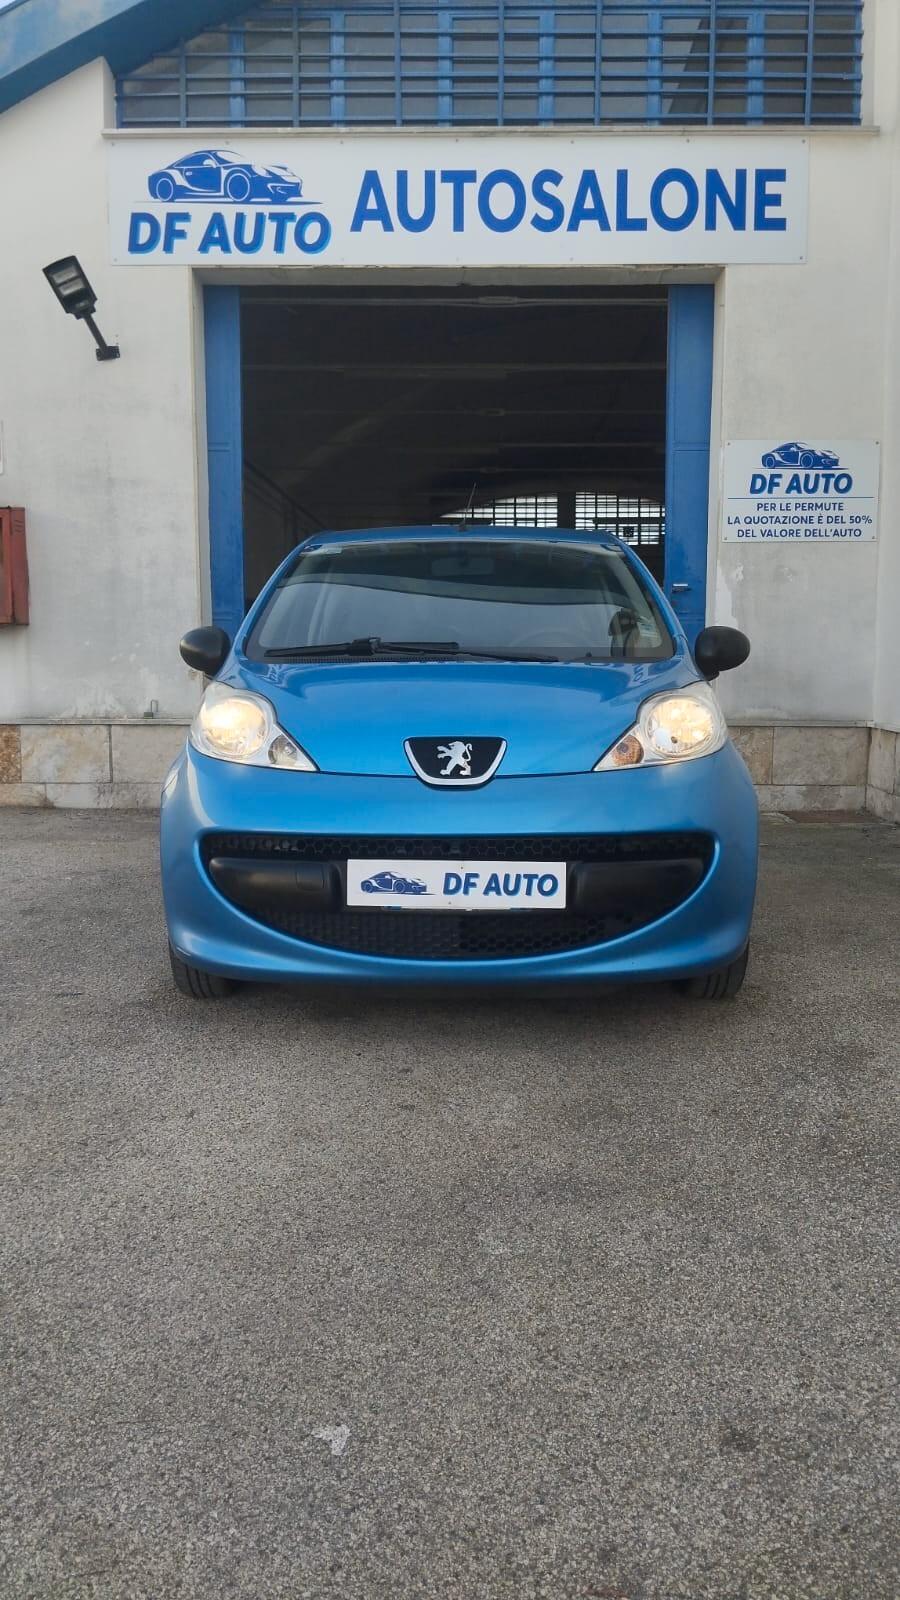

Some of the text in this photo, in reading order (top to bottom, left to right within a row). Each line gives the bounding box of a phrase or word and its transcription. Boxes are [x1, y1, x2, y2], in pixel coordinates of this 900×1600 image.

[350, 167, 788, 233] AUTOSALONE
[127, 211, 332, 255] DF AUTO
[750, 473, 853, 494] DF AUTO
[756, 502, 844, 512] PER LE PERMUTE
[727, 512, 873, 525] LA QUOTAZIONE È DEL 50%
[737, 529, 757, 538] DEL
[760, 529, 801, 538] VALORE
[443, 872, 559, 897] DF AUTO
